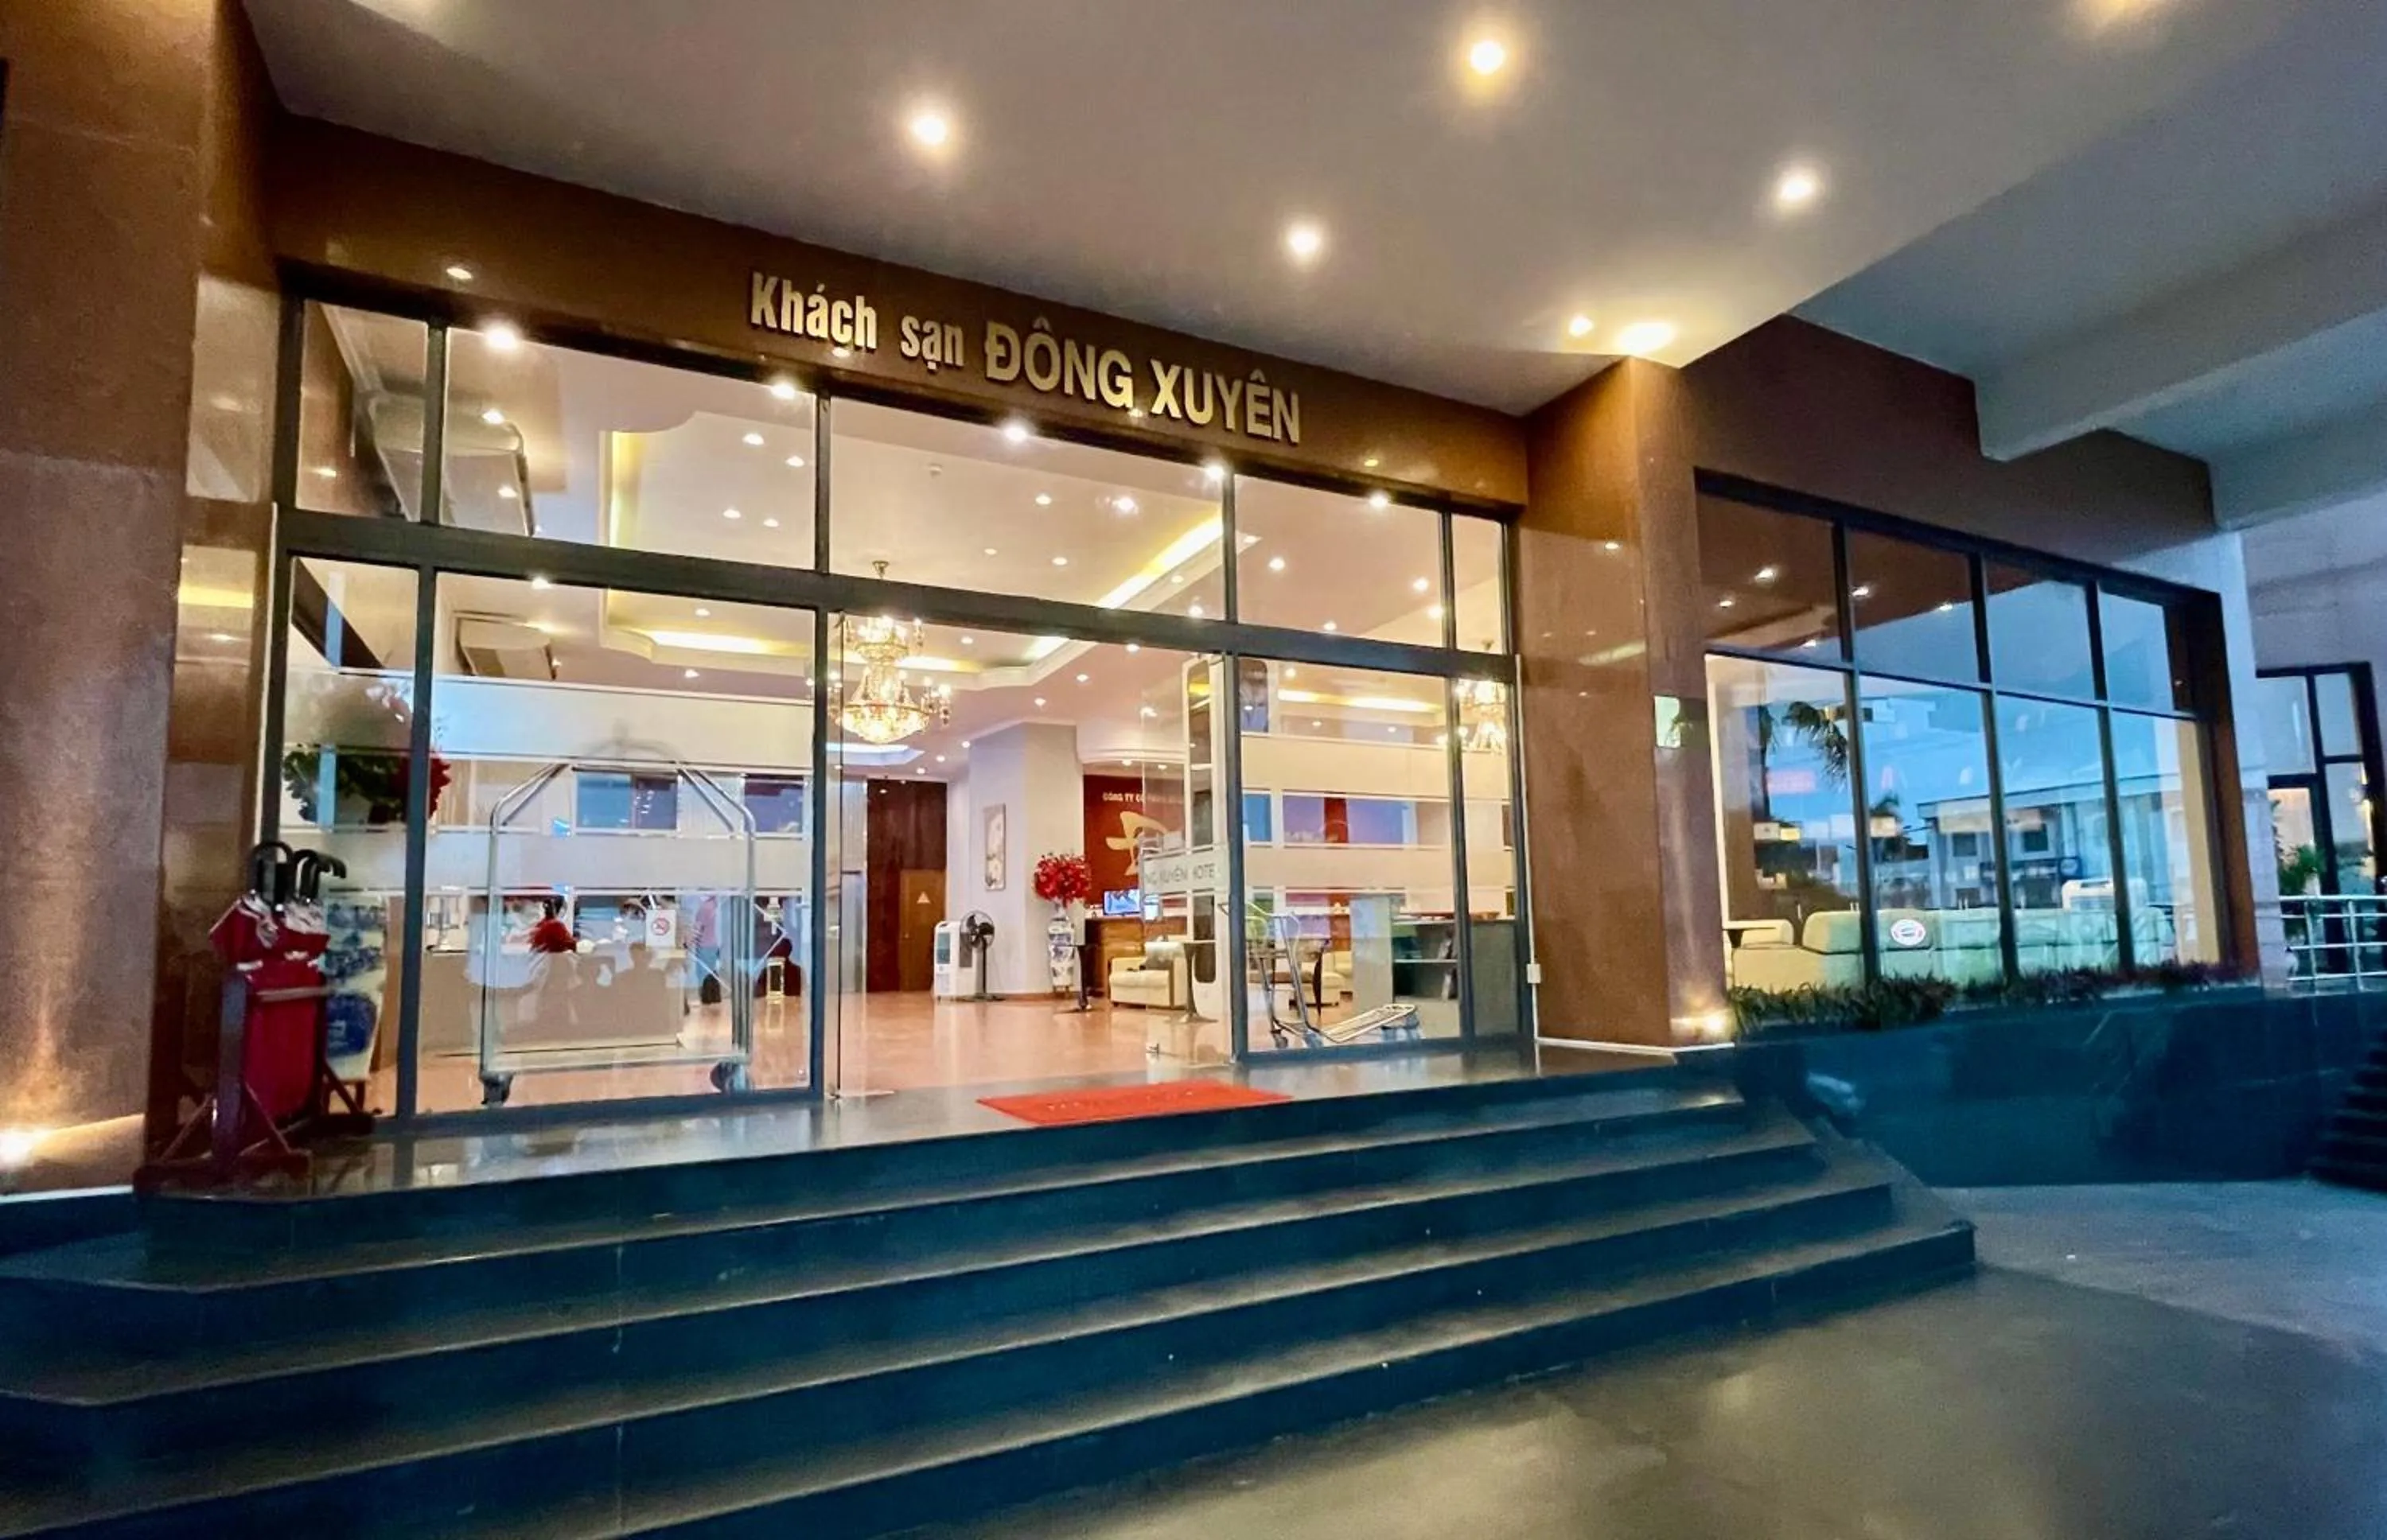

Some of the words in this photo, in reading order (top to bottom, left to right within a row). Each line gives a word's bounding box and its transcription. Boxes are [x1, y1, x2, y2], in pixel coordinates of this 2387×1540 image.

[751, 273, 877, 349] Khách
[901, 315, 964, 371] sạn
[984, 317, 1134, 409] ĐÔNG
[1150, 358, 1299, 444] XUYÊN
[1124, 792, 1134, 803] TY
